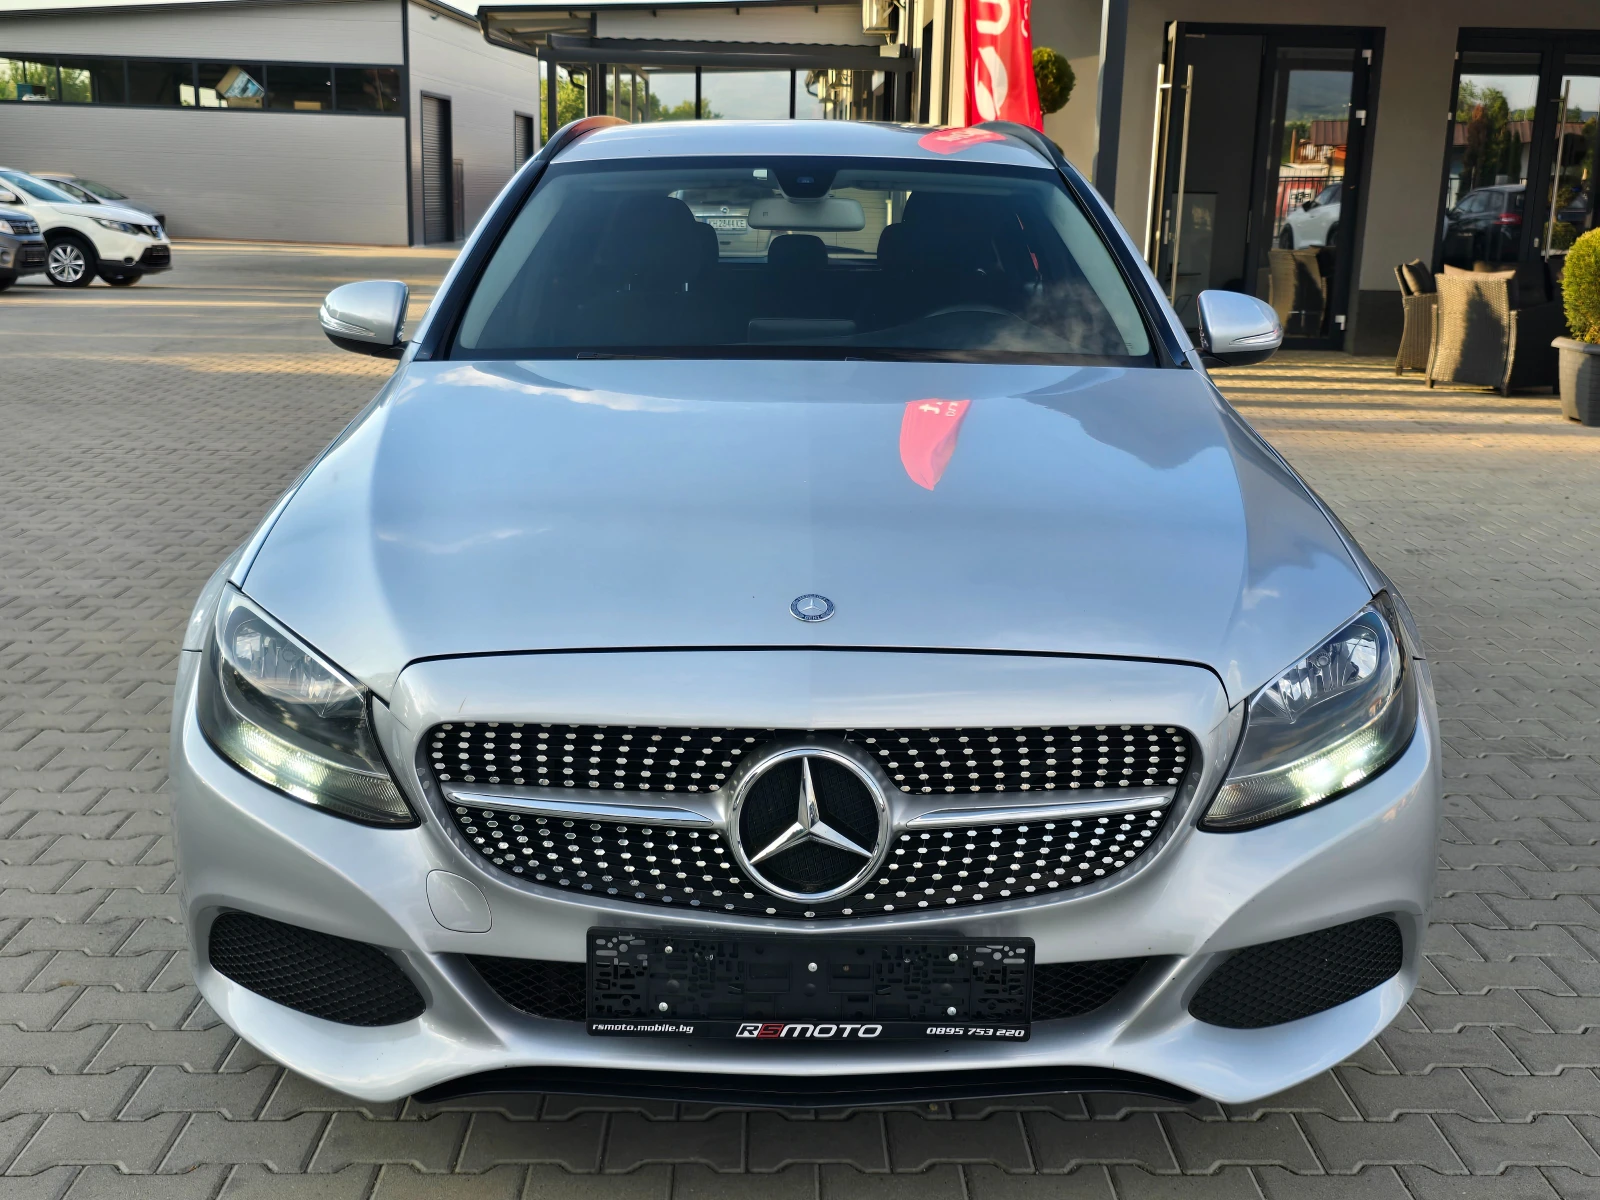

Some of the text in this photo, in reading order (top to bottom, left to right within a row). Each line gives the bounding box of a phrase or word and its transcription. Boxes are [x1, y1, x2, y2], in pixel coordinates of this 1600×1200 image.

[592, 1023, 694, 1034] rsmoto.mobile.bg
[735, 1023, 883, 1039] RSMOTO
[926, 1027, 1025, 1037] 0895 753 220
